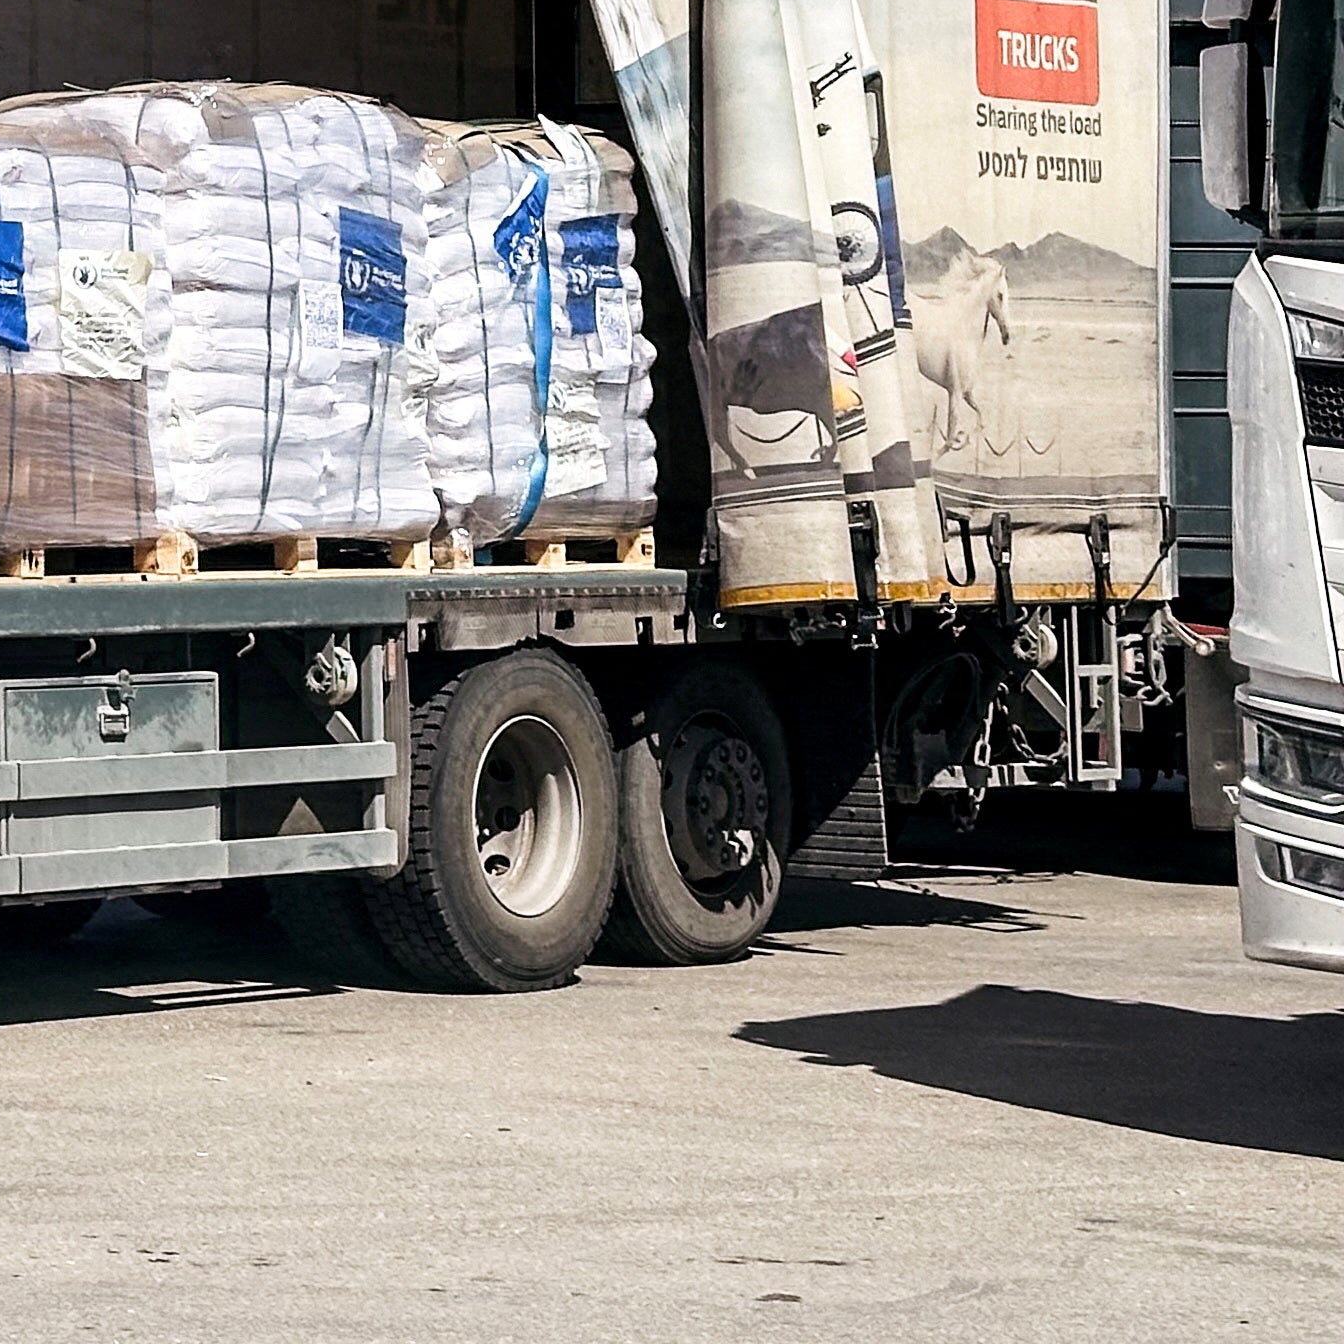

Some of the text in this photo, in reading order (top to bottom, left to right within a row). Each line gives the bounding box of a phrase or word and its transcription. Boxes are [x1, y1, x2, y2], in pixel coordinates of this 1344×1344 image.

[996, 29, 1080, 73] TRUCKS
[976, 102, 1102, 137] Sharing the load
[978, 146, 1102, 183] שותפים למסע
